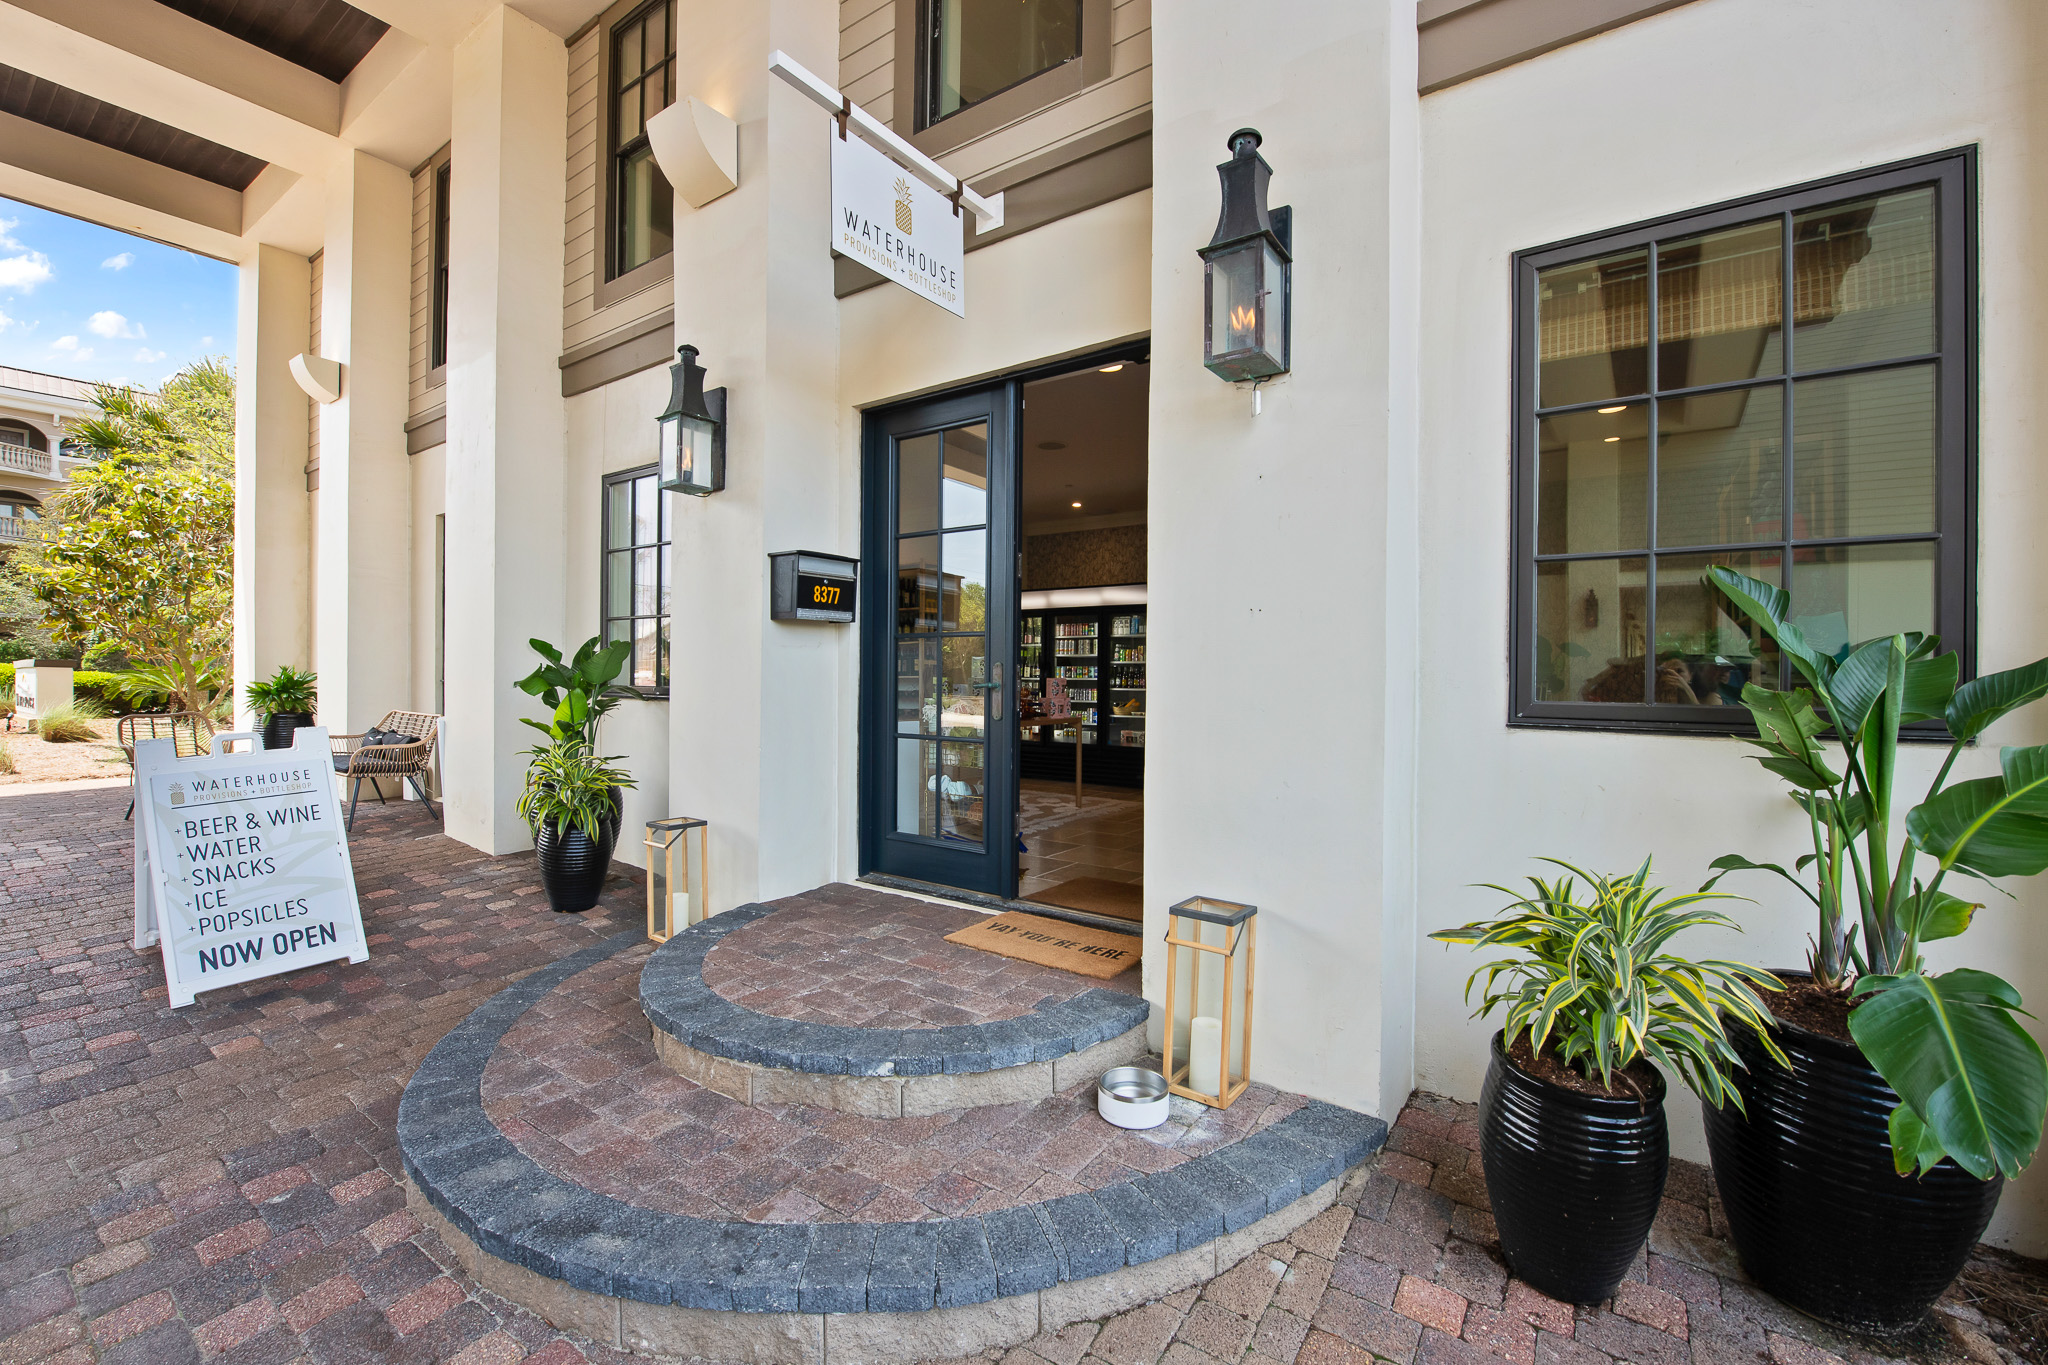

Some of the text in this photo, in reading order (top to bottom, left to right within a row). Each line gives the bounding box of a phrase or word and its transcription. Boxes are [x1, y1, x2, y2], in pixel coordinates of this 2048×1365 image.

[844, 207, 956, 289] WATERHOUSE
[844, 233, 897, 272] PROVISIONS
[908, 270, 957, 304] BOTTLESHOP
[813, 585, 841, 605] 8377
[191, 769, 312, 792] WATERHOUSE
[193, 789, 248, 802] PROVISIONS
[260, 782, 312, 795] BOTTLESHOP
[184, 815, 239, 839] BEER
[246, 812, 262, 830] &
[267, 804, 322, 827] WINE
[186, 836, 262, 863] WATER
[192, 857, 276, 887] SNACKS
[194, 889, 229, 912] ICE
[198, 898, 309, 936] POPSICLES
[198, 922, 338, 973] NOW OPEN
[1078, 945, 1129, 961] HERE
